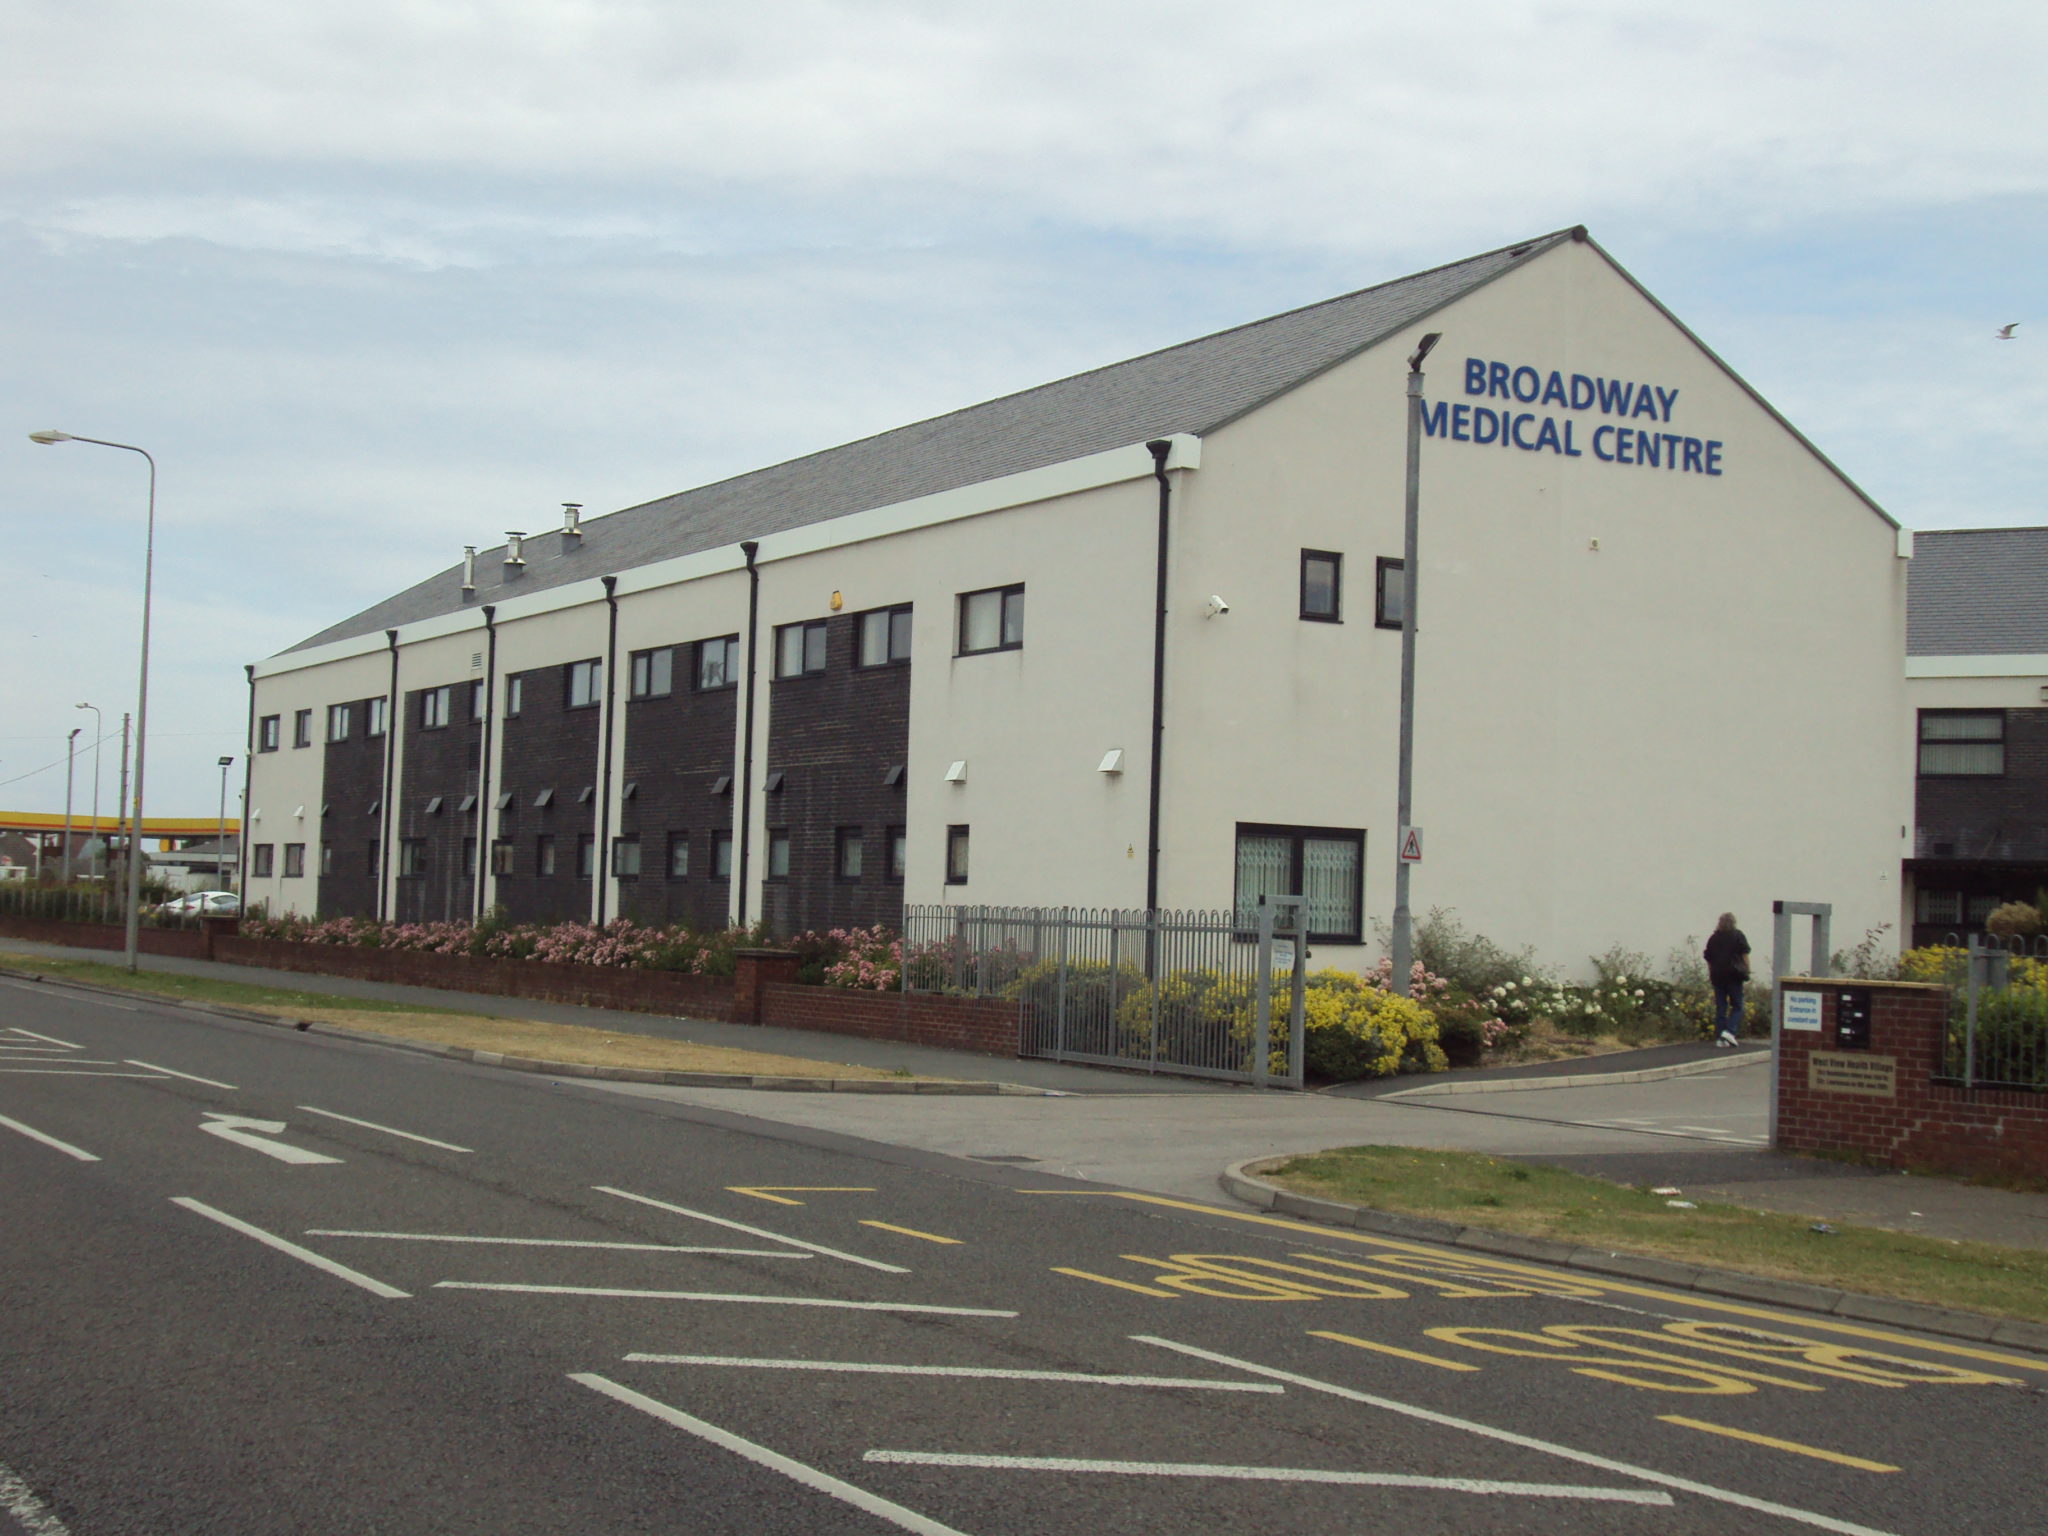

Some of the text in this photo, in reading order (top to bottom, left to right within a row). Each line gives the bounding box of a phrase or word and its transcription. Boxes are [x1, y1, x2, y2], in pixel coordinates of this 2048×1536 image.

[1465, 357, 1679, 422] BROADWAY
[1420, 399, 1723, 476] MEDICAL CENTRE
[1120, 1254, 1603, 1301] STOP
[1423, 1321, 2025, 1395] BUS
